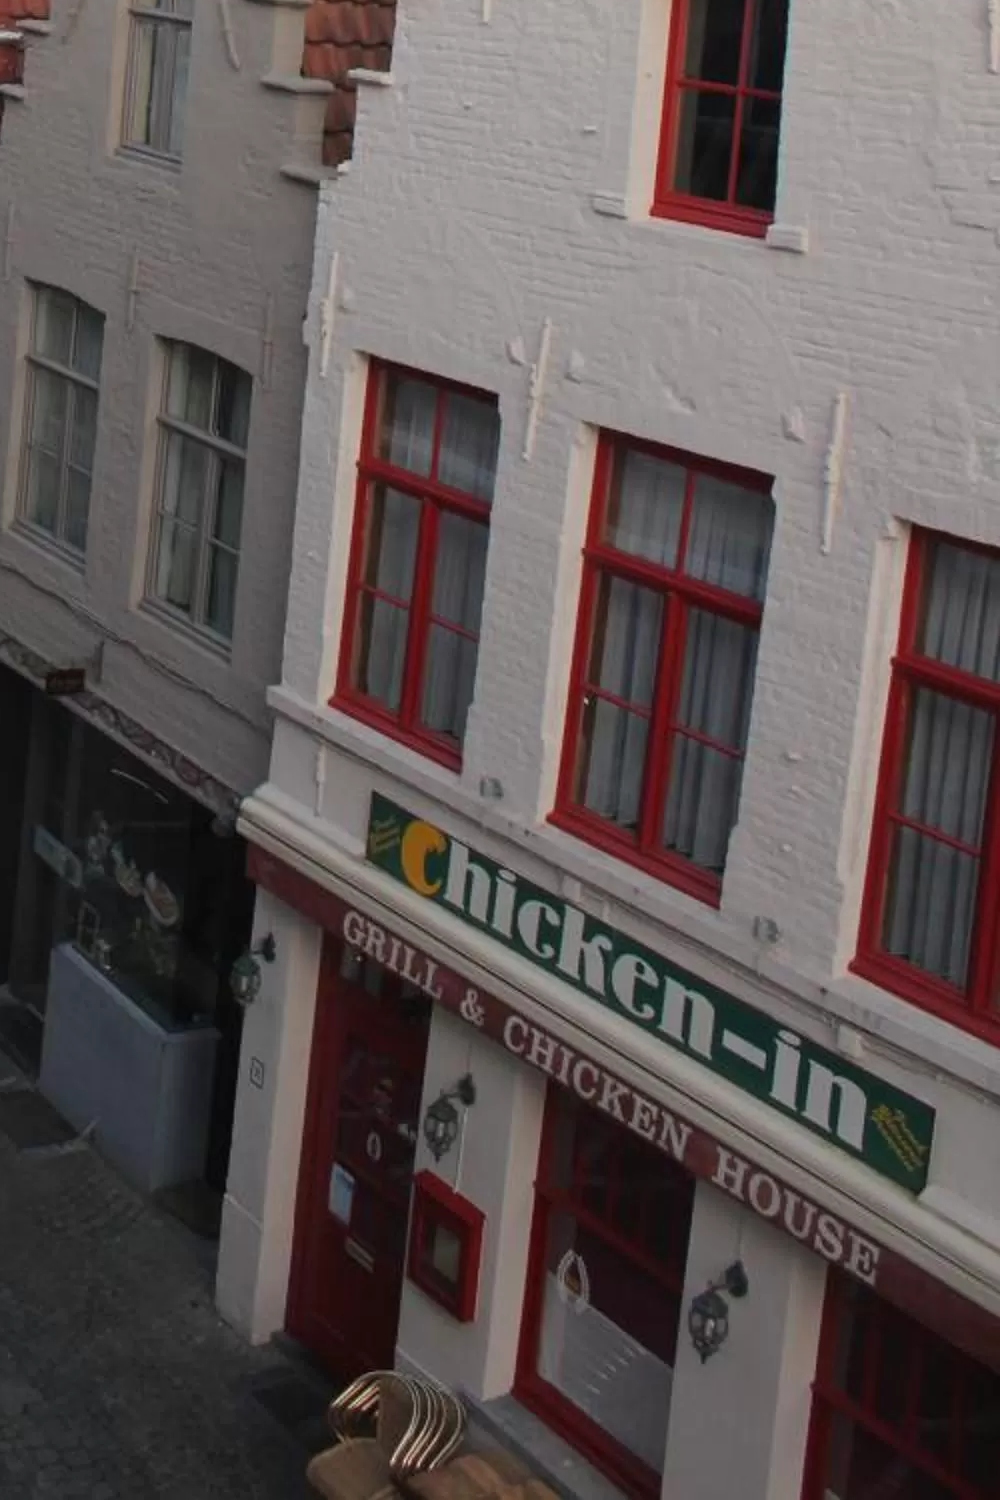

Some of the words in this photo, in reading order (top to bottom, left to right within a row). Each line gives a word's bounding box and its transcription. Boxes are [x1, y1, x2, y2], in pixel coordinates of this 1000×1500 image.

[343, 910, 444, 1000] GRILL
[459, 988, 485, 1027] &
[502, 1015, 694, 1163] CHICKEN
[711, 1146, 881, 1287] HOUSE
